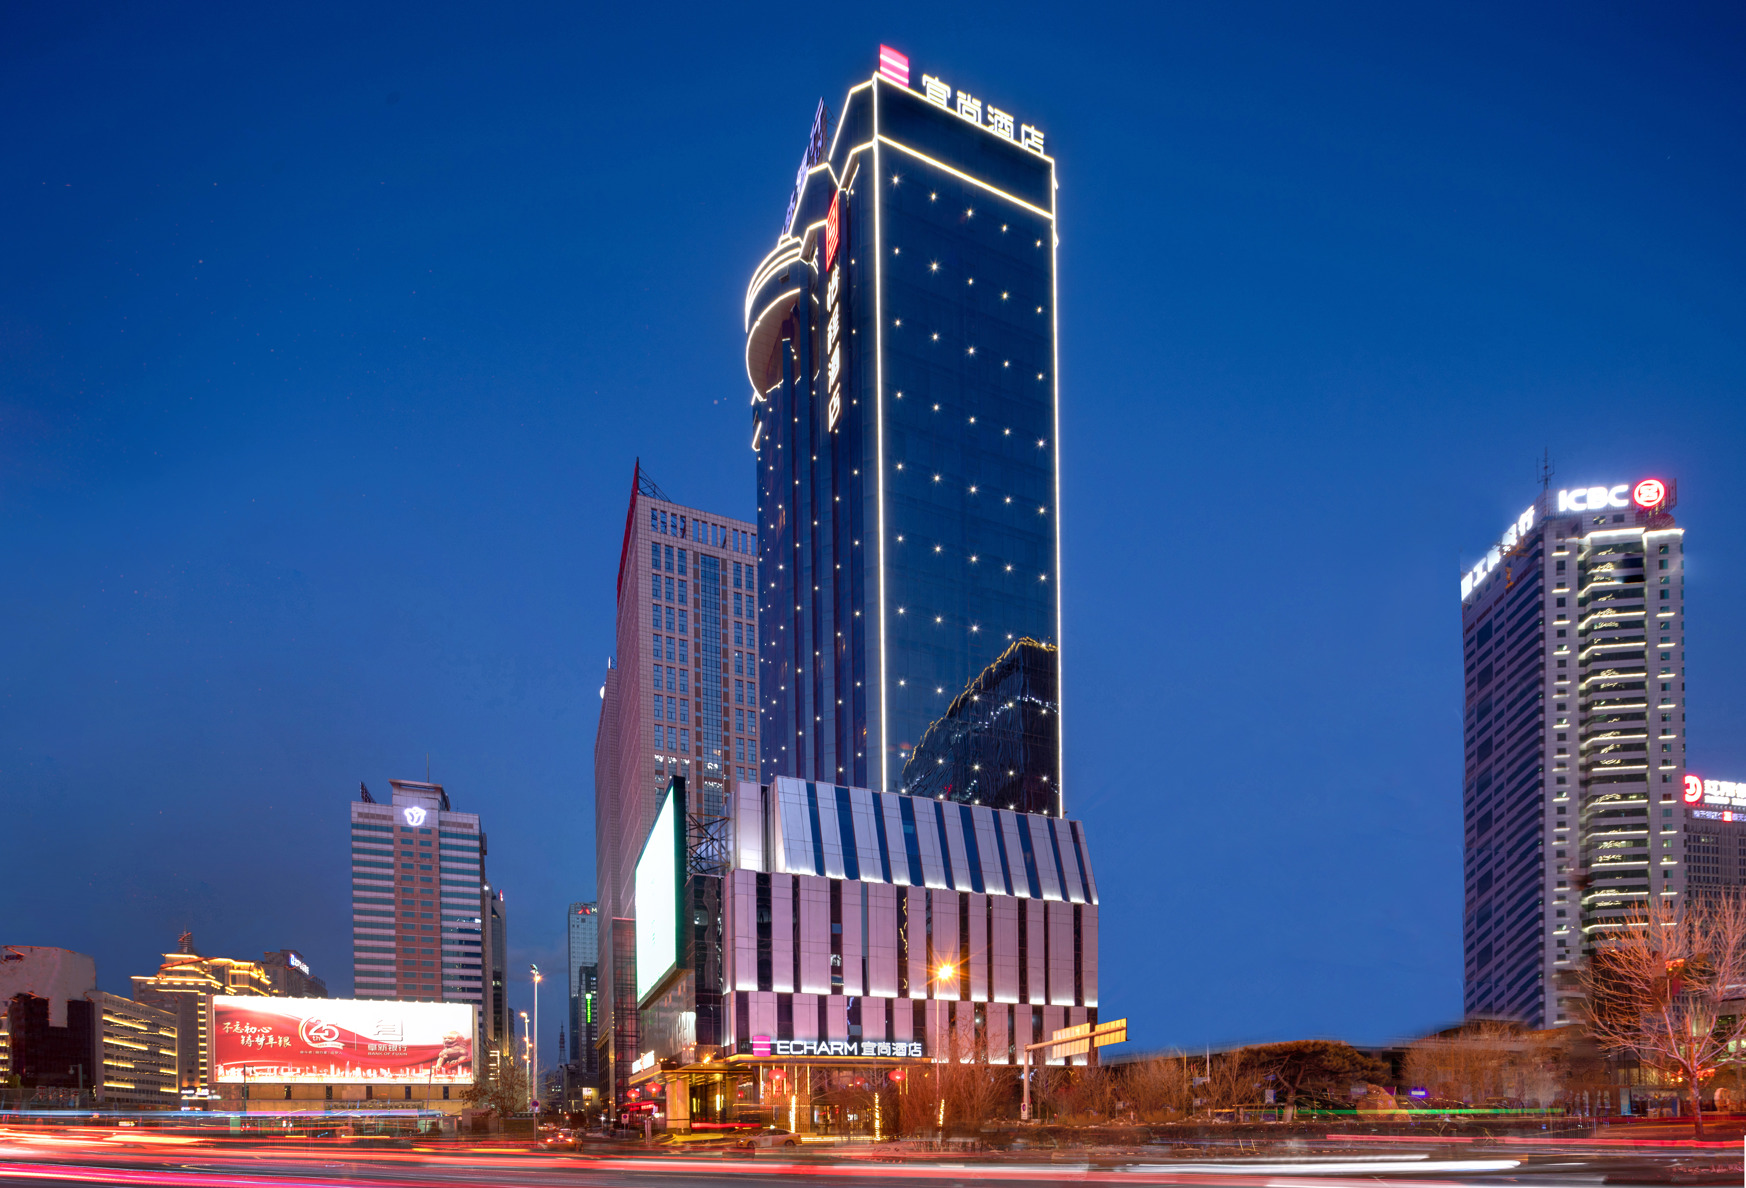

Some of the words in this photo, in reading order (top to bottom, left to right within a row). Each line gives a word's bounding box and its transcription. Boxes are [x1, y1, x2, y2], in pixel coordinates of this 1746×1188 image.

[922, 73, 1045, 155] 宜尚酒店
[1558, 484, 1629, 511] ICBC
[222, 1021, 272, 1034] 不忘初心
[776, 1040, 858, 1055] ECHARM
[861, 1041, 922, 1057] 宜尚酒店
